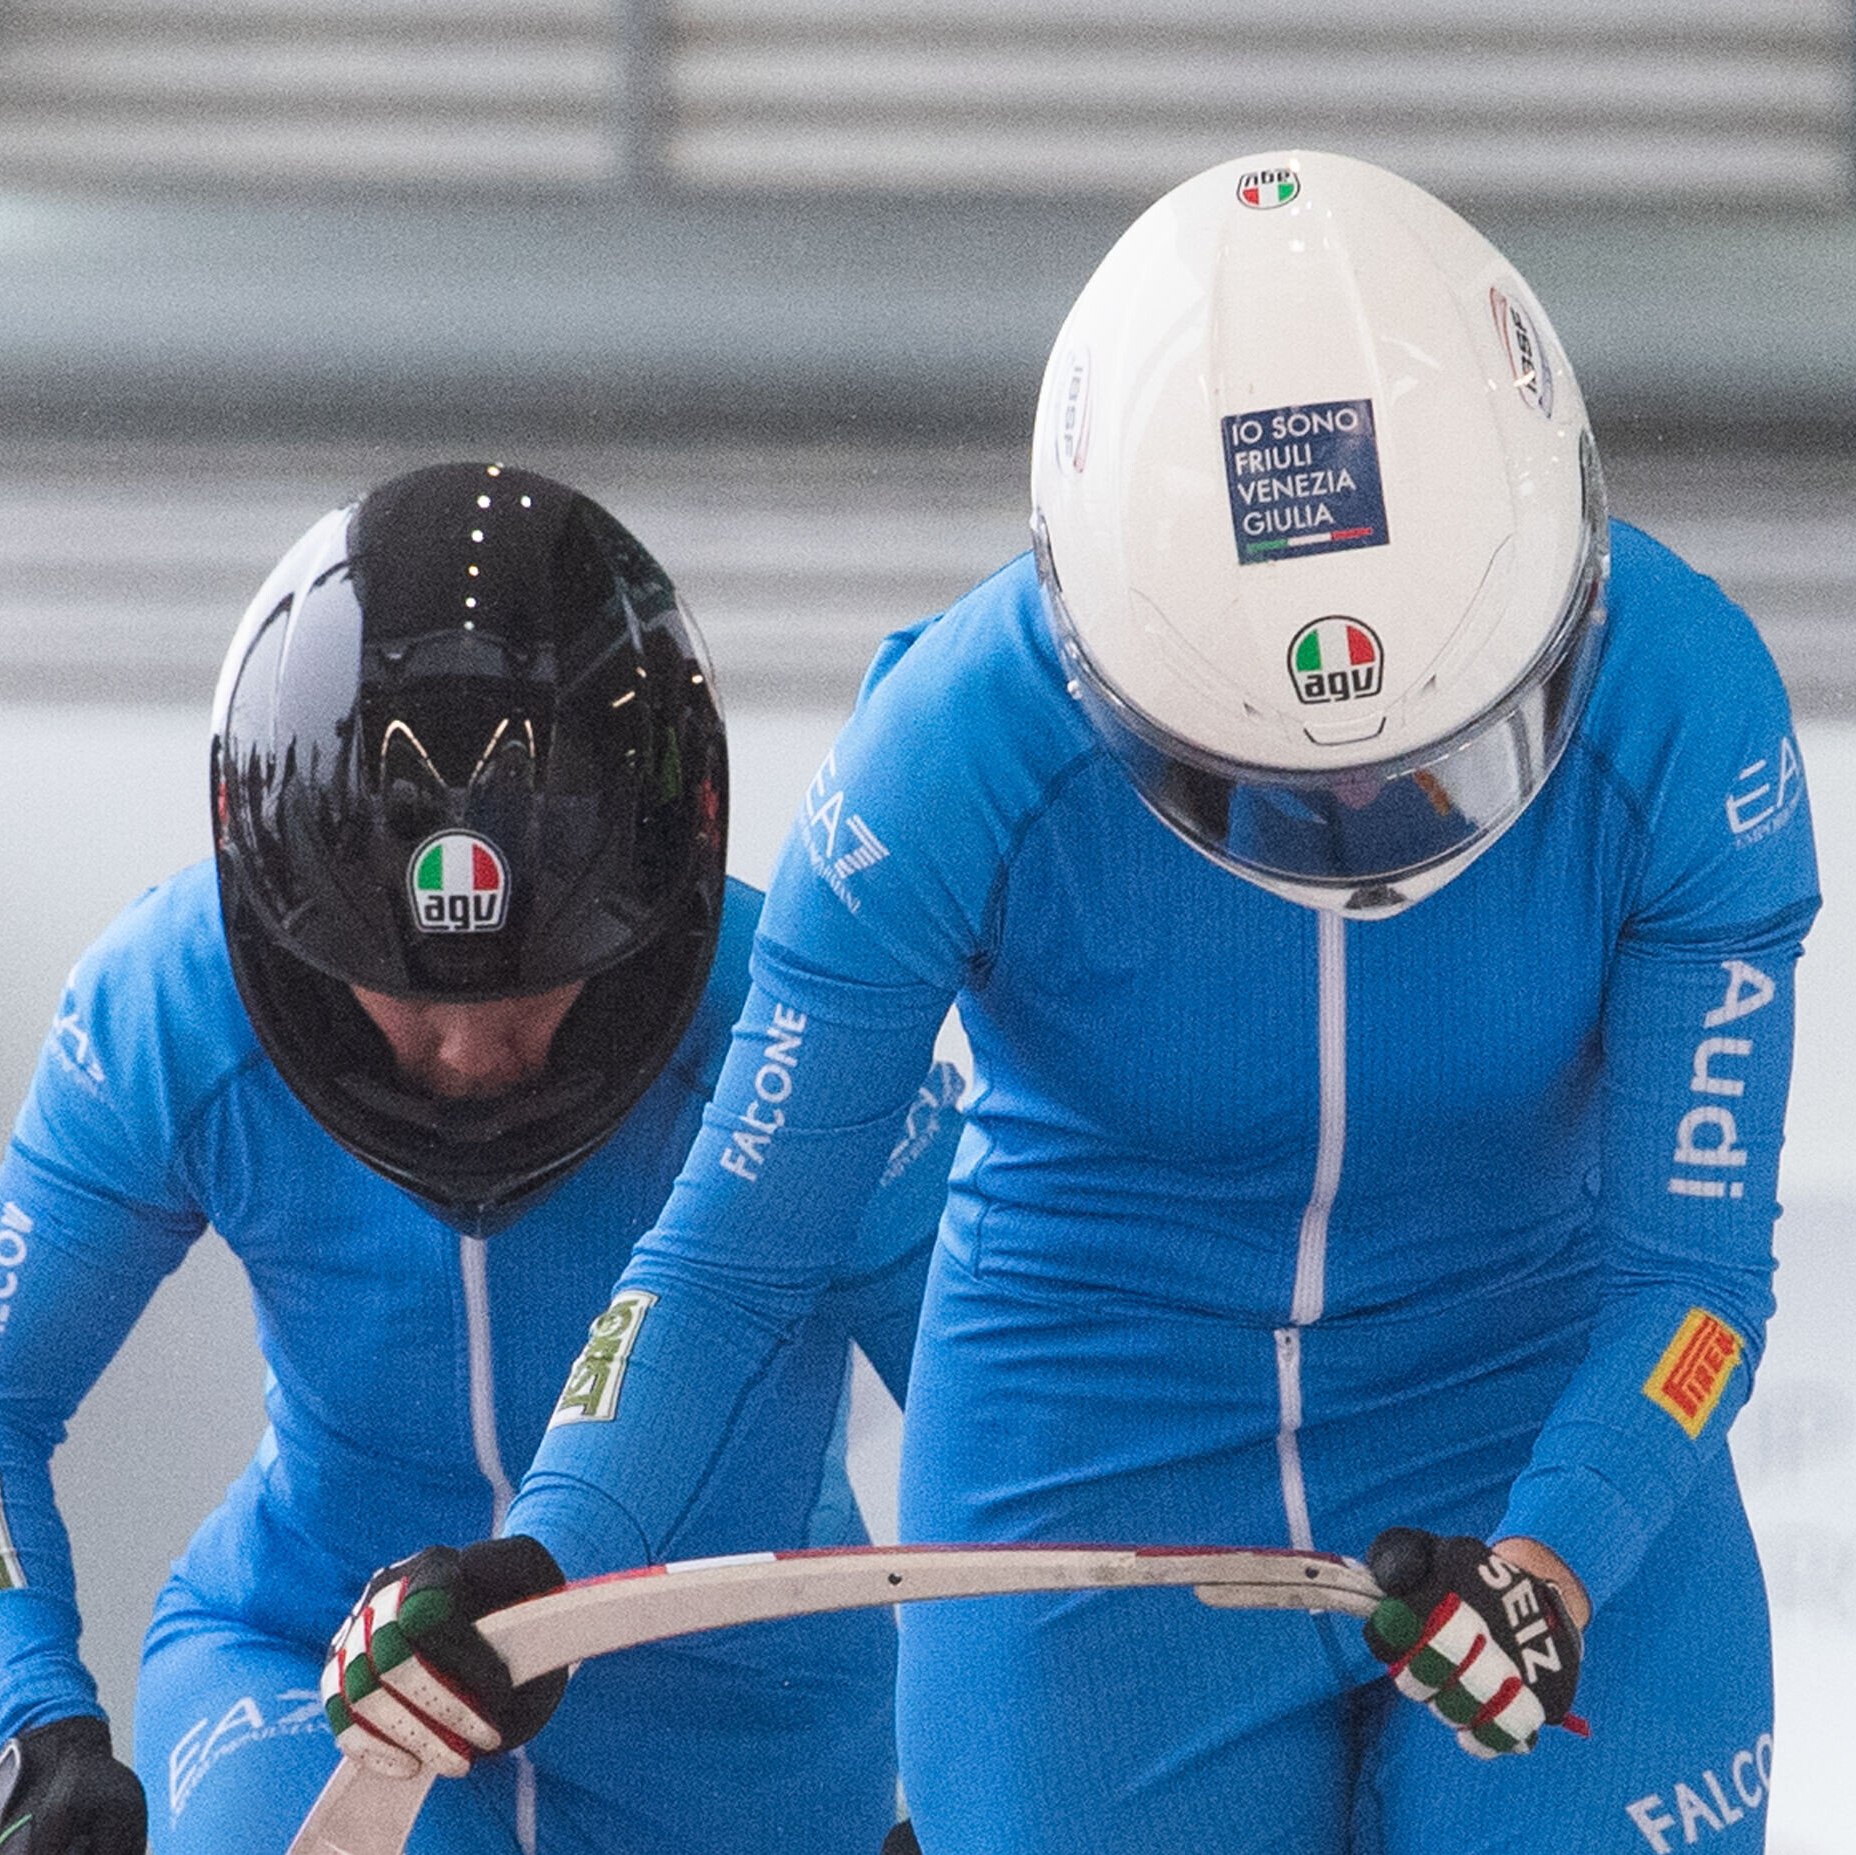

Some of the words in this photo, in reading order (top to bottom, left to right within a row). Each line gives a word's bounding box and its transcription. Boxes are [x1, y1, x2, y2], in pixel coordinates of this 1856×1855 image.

[1231, 420, 1263, 446] IO
[1272, 408, 1358, 440] SONO
[1235, 442, 1312, 476] FRIULI
[1238, 468, 1357, 506] VENEZIA
[1243, 502, 1335, 536] GIULIA
[1304, 666, 1374, 702] agv
[805, 752, 890, 879] EA7
[425, 893, 497, 930] agv
[719, 1002, 808, 1183] FALCONE
[1666, 959, 1775, 1199] Audi
[1477, 1555, 1562, 1684] SEIZ
